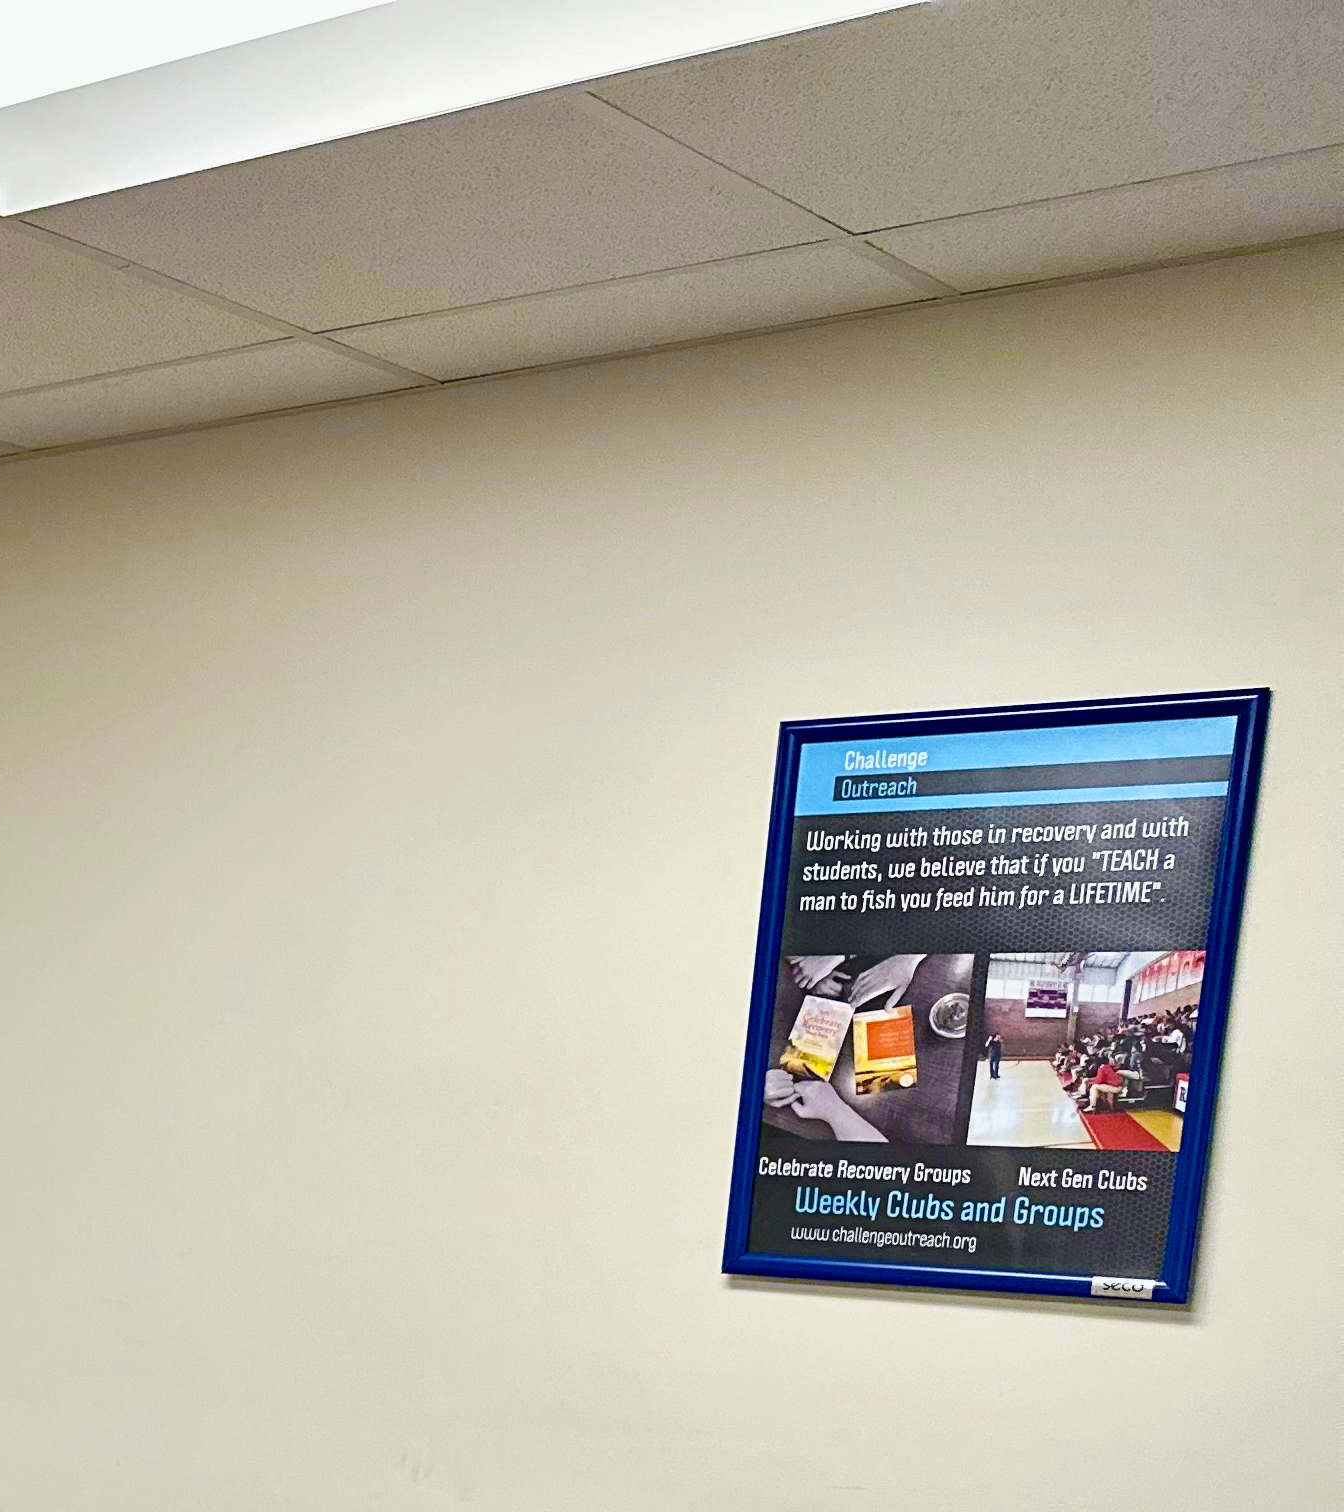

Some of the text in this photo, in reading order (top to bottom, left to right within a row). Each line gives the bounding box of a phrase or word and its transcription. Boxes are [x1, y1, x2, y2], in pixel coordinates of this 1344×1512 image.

[844, 750, 928, 771] Challenge
[841, 777, 917, 798] Outreach
[806, 816, 1189, 852] Working with those in recovery and with
[802, 848, 1176, 882] students, we believe that if you "TEACH a
[799, 881, 1165, 913] man to fish you feed him for a LIFETIME".
[758, 1156, 972, 1186] Celebrate Recovery Groups
[1018, 1166, 1149, 1191] Next Gen Clubs
[795, 1186, 1105, 1232] Weekly Clubs and Groups
